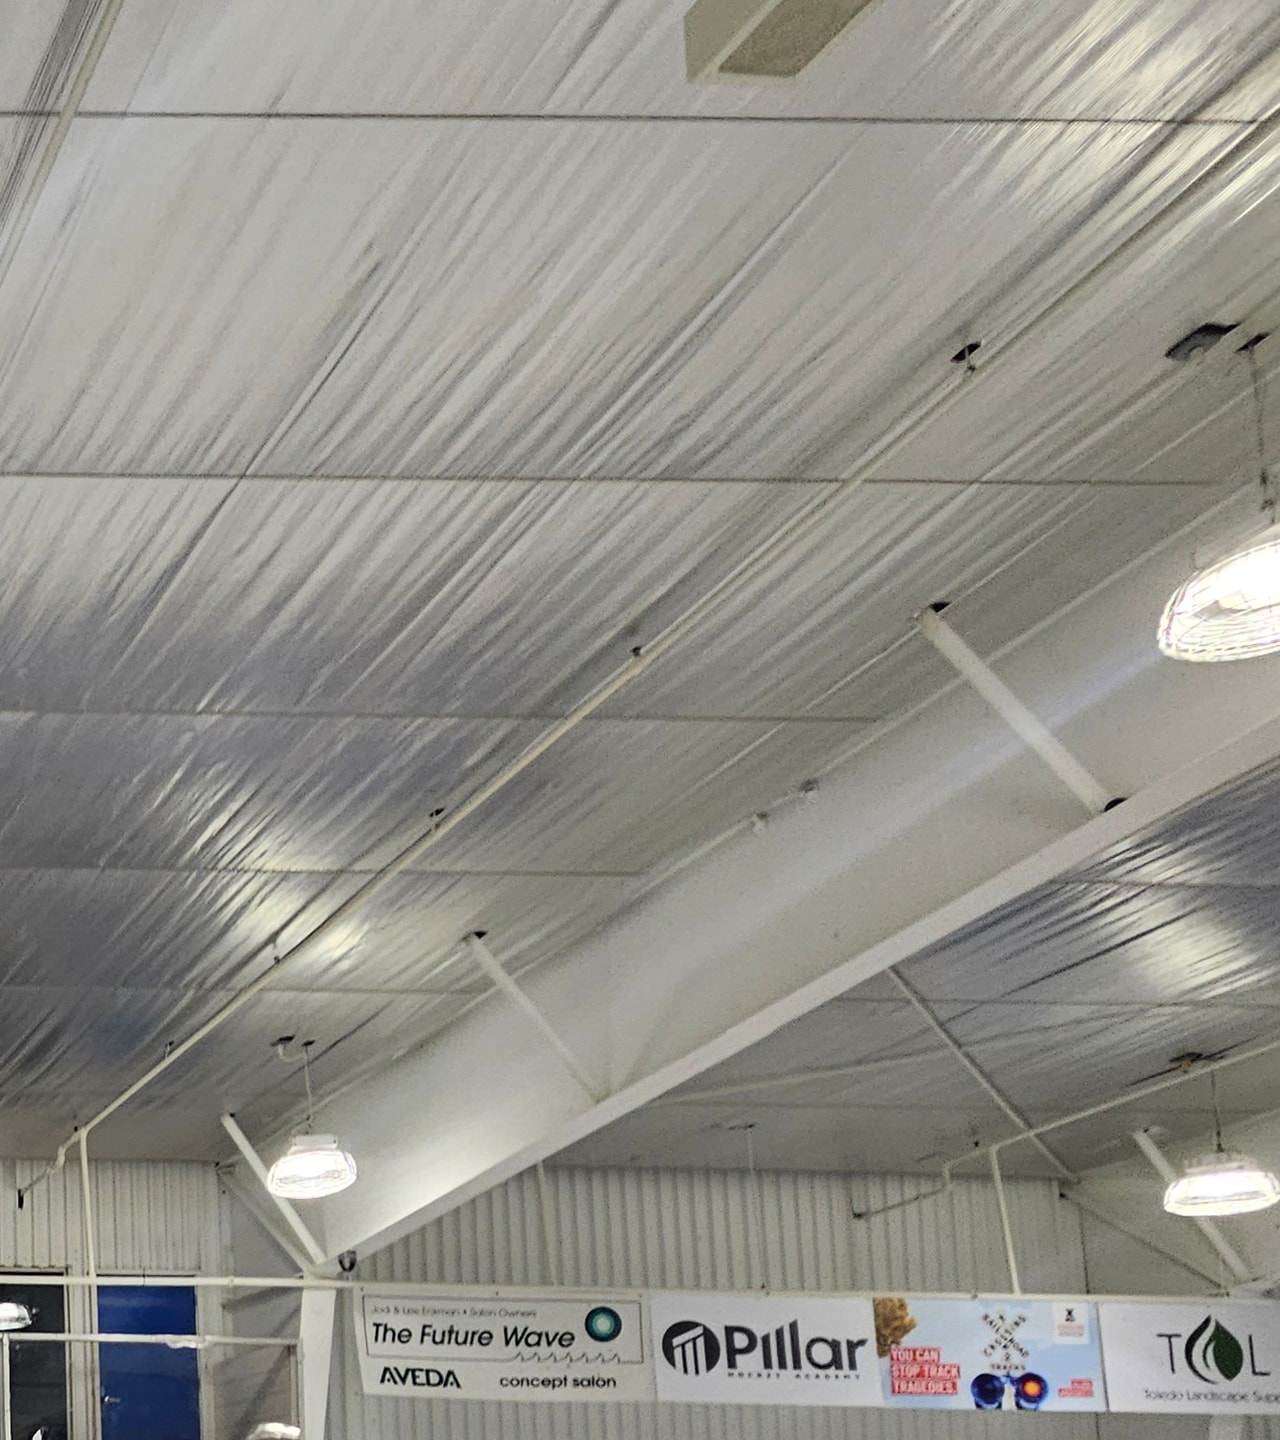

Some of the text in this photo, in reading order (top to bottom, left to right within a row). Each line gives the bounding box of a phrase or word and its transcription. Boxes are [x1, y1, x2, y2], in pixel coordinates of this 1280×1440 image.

[372, 1322, 576, 1348] The Future Wave
[724, 1319, 868, 1371] Pillar
[891, 1350, 939, 1362] YOU CAN
[380, 1366, 462, 1388] AVEDA
[892, 1365, 960, 1378] STOP TRACK
[499, 1373, 617, 1391] concept salon
